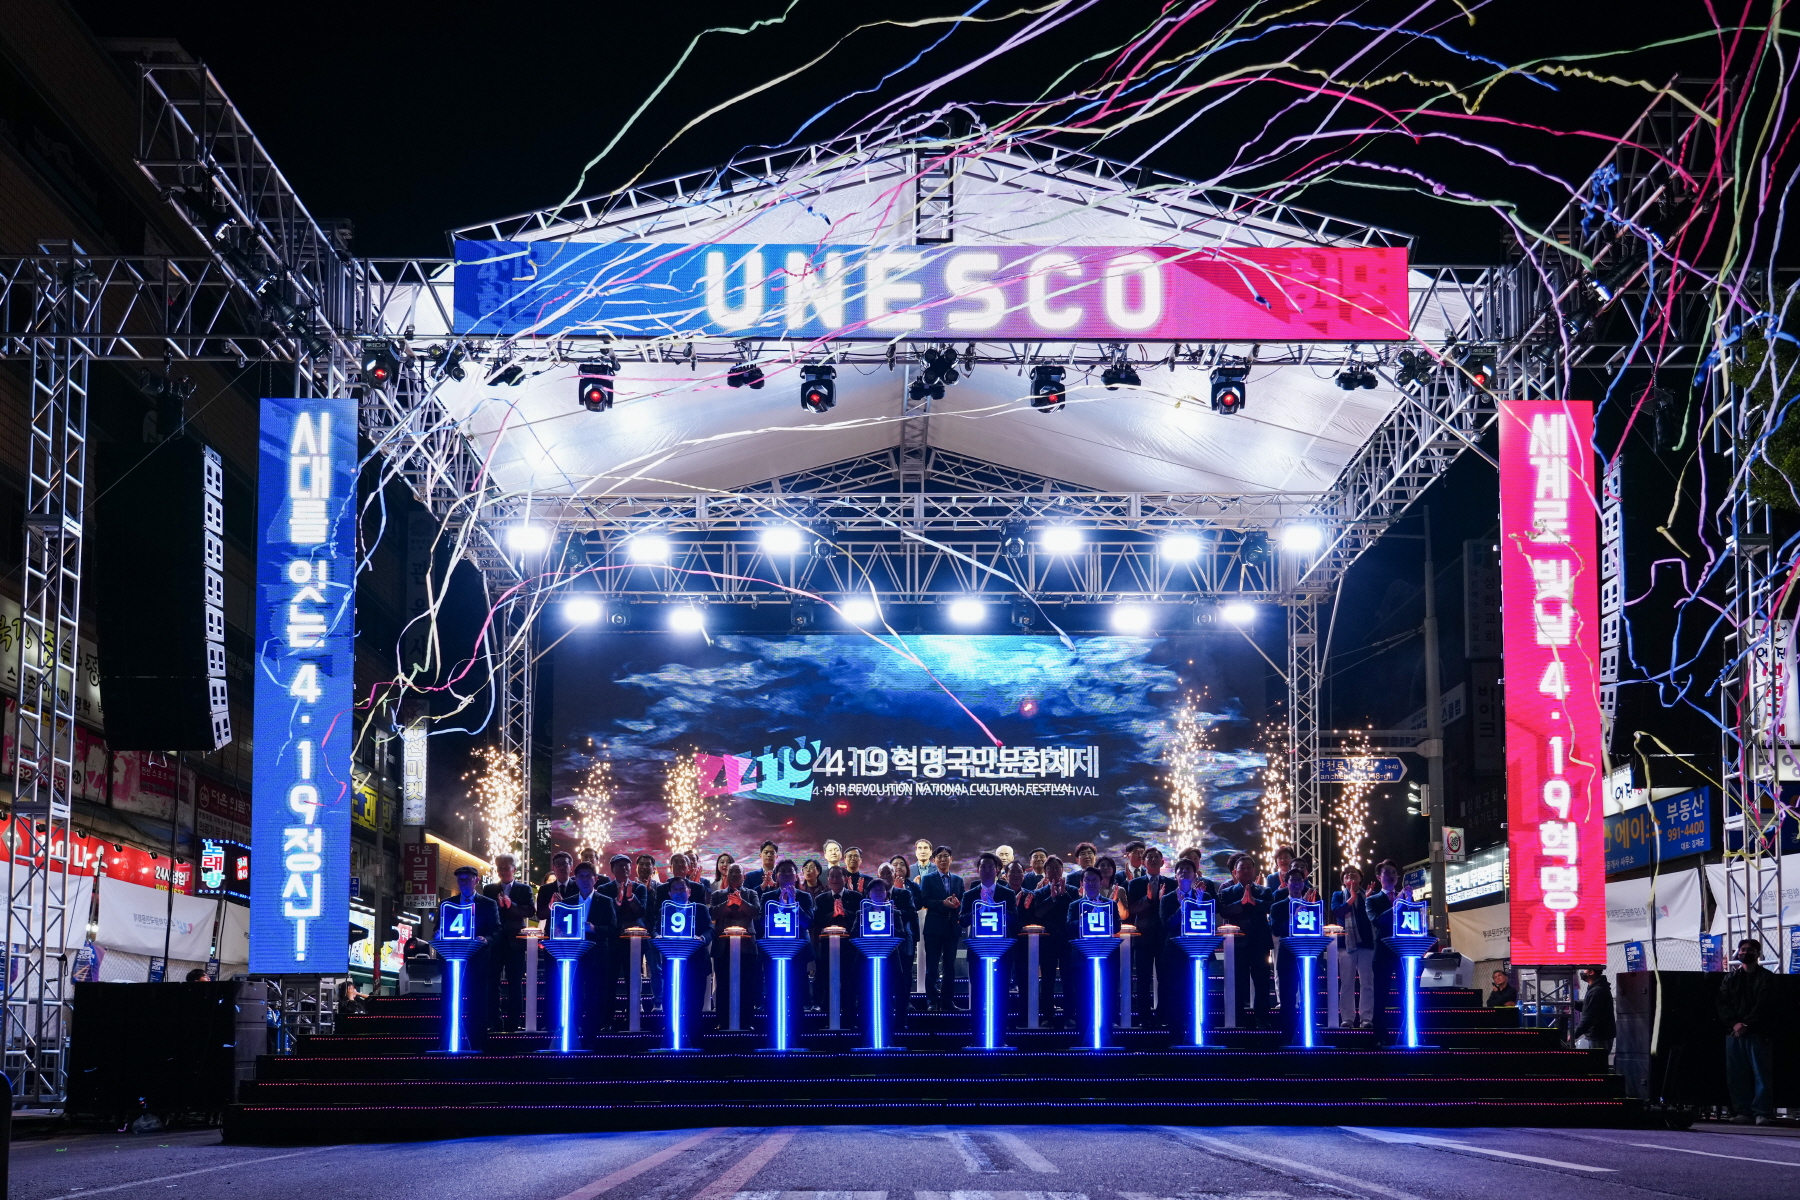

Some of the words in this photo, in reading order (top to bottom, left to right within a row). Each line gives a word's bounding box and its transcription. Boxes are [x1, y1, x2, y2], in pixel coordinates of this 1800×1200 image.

[705, 251, 1165, 332] UNESCO
[288, 411, 330, 543] 시대를
[286, 560, 327, 647] 잇는
[282, 664, 322, 961] 4·19정신!
[1538, 660, 1579, 953] 4·19혁명!
[1666, 794, 1704, 825] 부동산
[1667, 820, 1705, 842] 991-4400
[201, 840, 225, 889] 노래방
[409, 845, 433, 855] 더온
[412, 856, 429, 894] 의료기
[450, 914, 465, 934] 4
[563, 914, 573, 934] 1
[670, 913, 685, 933] 9
[773, 912, 790, 933] 혁
[868, 911, 885, 931] 명
[980, 911, 999, 931] 국
[1087, 911, 1105, 931] 민
[1189, 910, 1207, 930] 문
[1297, 910, 1316, 931] 화
[1401, 911, 1420, 931] 제
